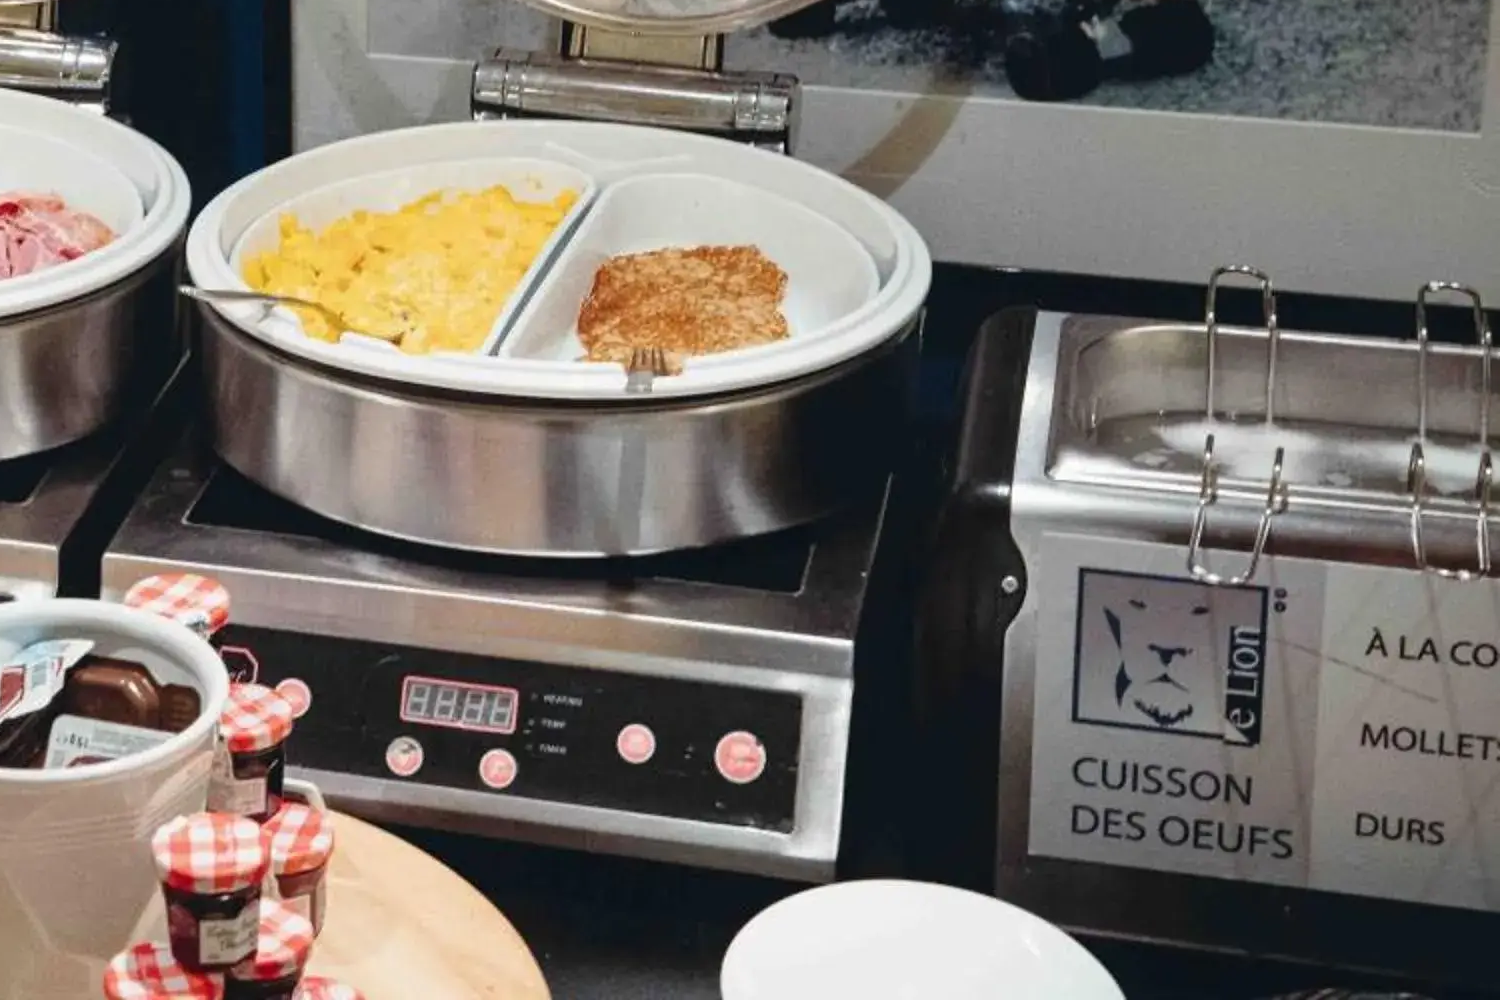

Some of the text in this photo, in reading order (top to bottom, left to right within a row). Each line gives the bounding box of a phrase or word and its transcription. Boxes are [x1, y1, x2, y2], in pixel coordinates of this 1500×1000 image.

[1225, 625, 1263, 698] Lion
[1365, 626, 1389, 658] À
[1398, 634, 1440, 664] LA
[1359, 722, 1500, 762] MOLLET
[1072, 756, 1254, 806] CUISSON
[1071, 804, 1295, 860] DES OEUFS
[1355, 811, 1446, 846] DURS
